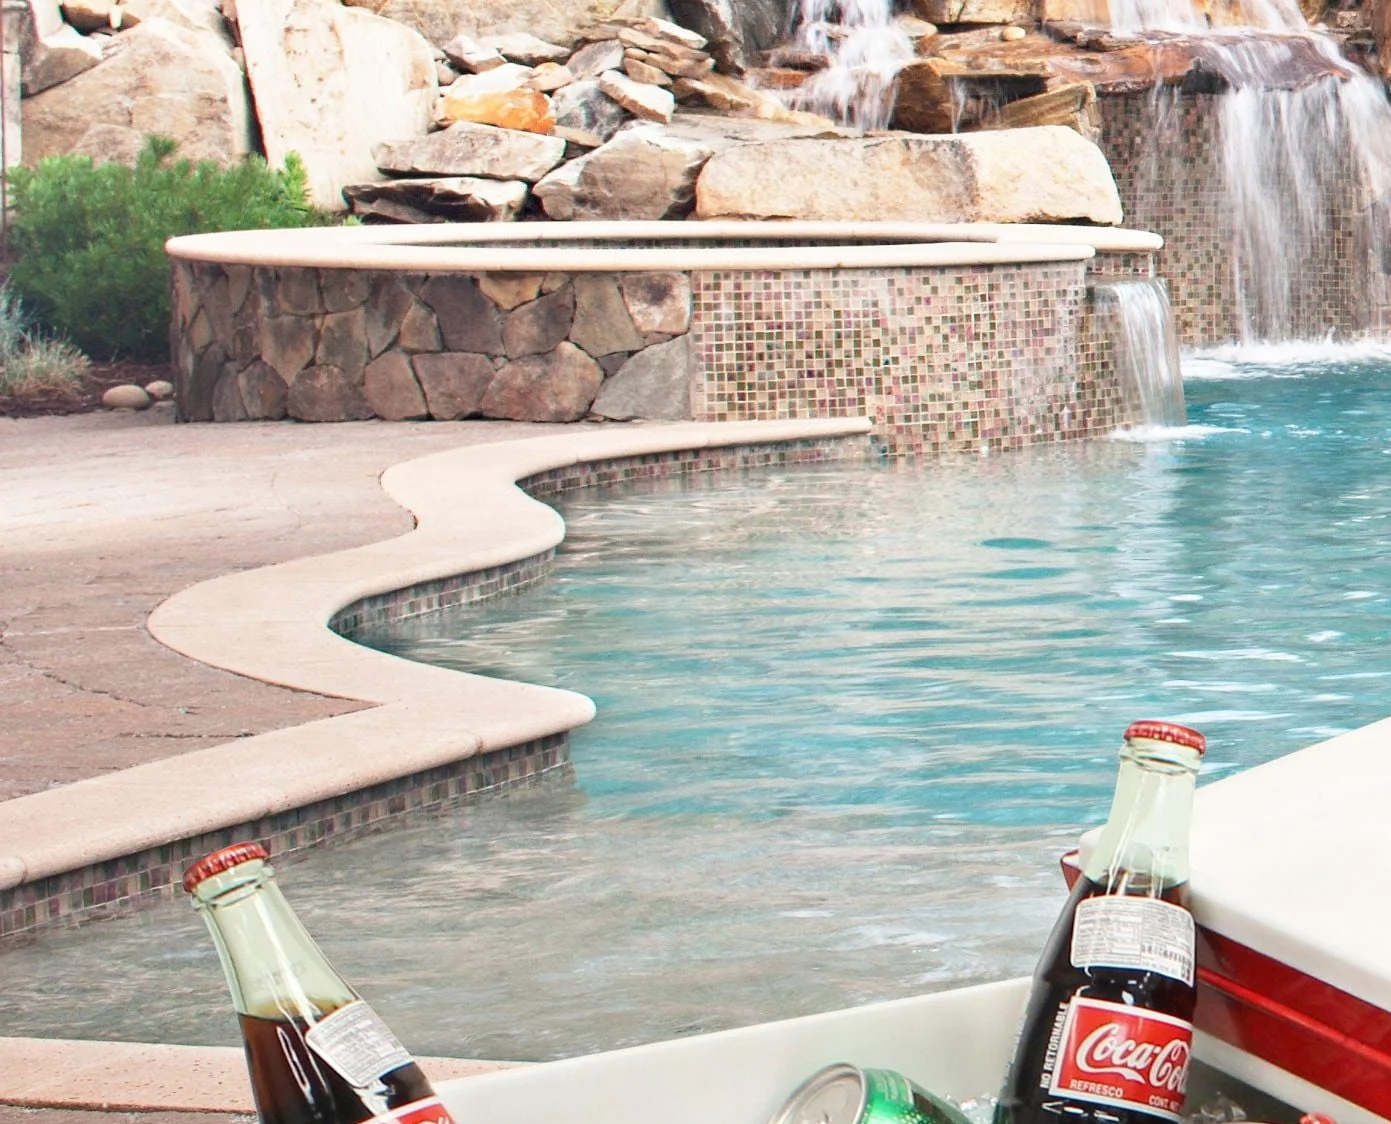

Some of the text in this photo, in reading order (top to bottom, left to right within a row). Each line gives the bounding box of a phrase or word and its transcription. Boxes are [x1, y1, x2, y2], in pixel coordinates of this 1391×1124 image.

[1040, 1002, 1071, 1088] NO RETORNABLE
[1070, 1079, 1123, 1098] REFRESCO
